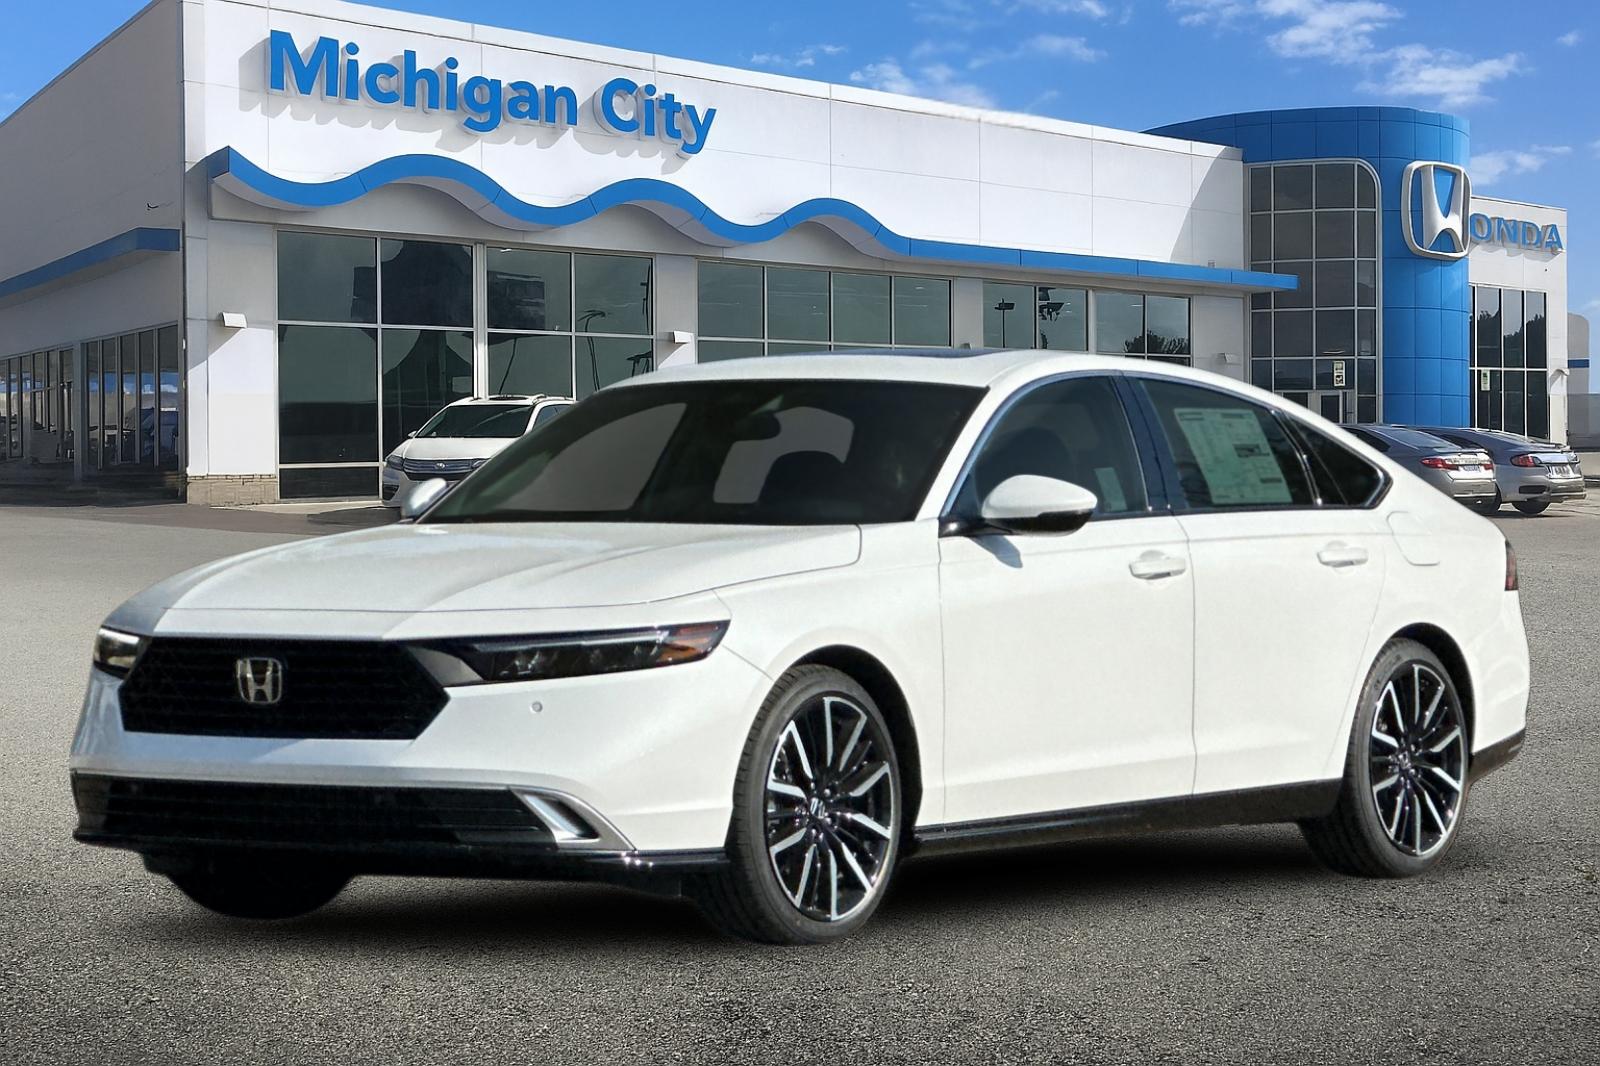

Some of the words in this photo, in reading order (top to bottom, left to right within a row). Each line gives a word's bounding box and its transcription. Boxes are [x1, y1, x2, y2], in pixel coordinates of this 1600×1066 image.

[269, 29, 578, 133] Michigan
[600, 77, 717, 155] City
[1469, 212, 1563, 250] ONDA
